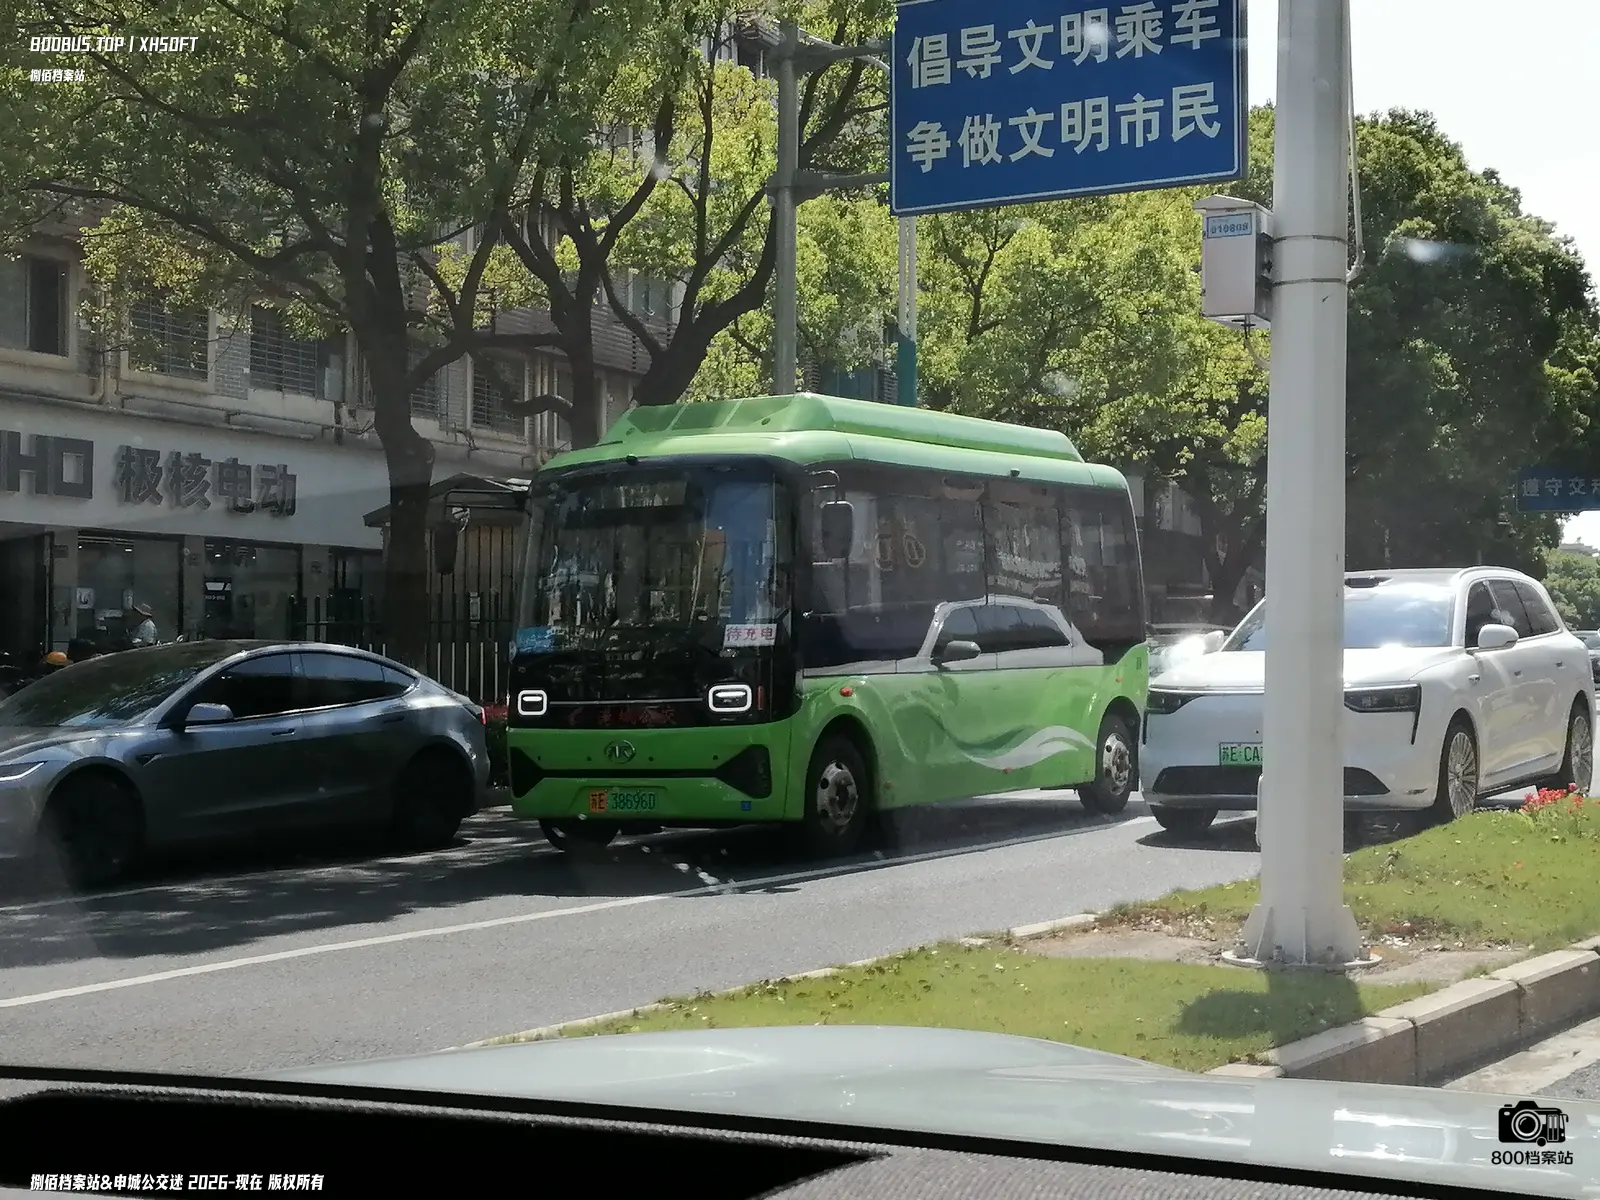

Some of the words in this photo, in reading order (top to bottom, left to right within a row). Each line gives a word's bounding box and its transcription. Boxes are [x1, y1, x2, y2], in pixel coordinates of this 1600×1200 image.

[906, 0, 1221, 89] 倡导文明乘车
[906, 81, 1222, 174] 争做文明市民
[116, 444, 298, 517] 极核电动
[726, 626, 775, 642] 待充电
